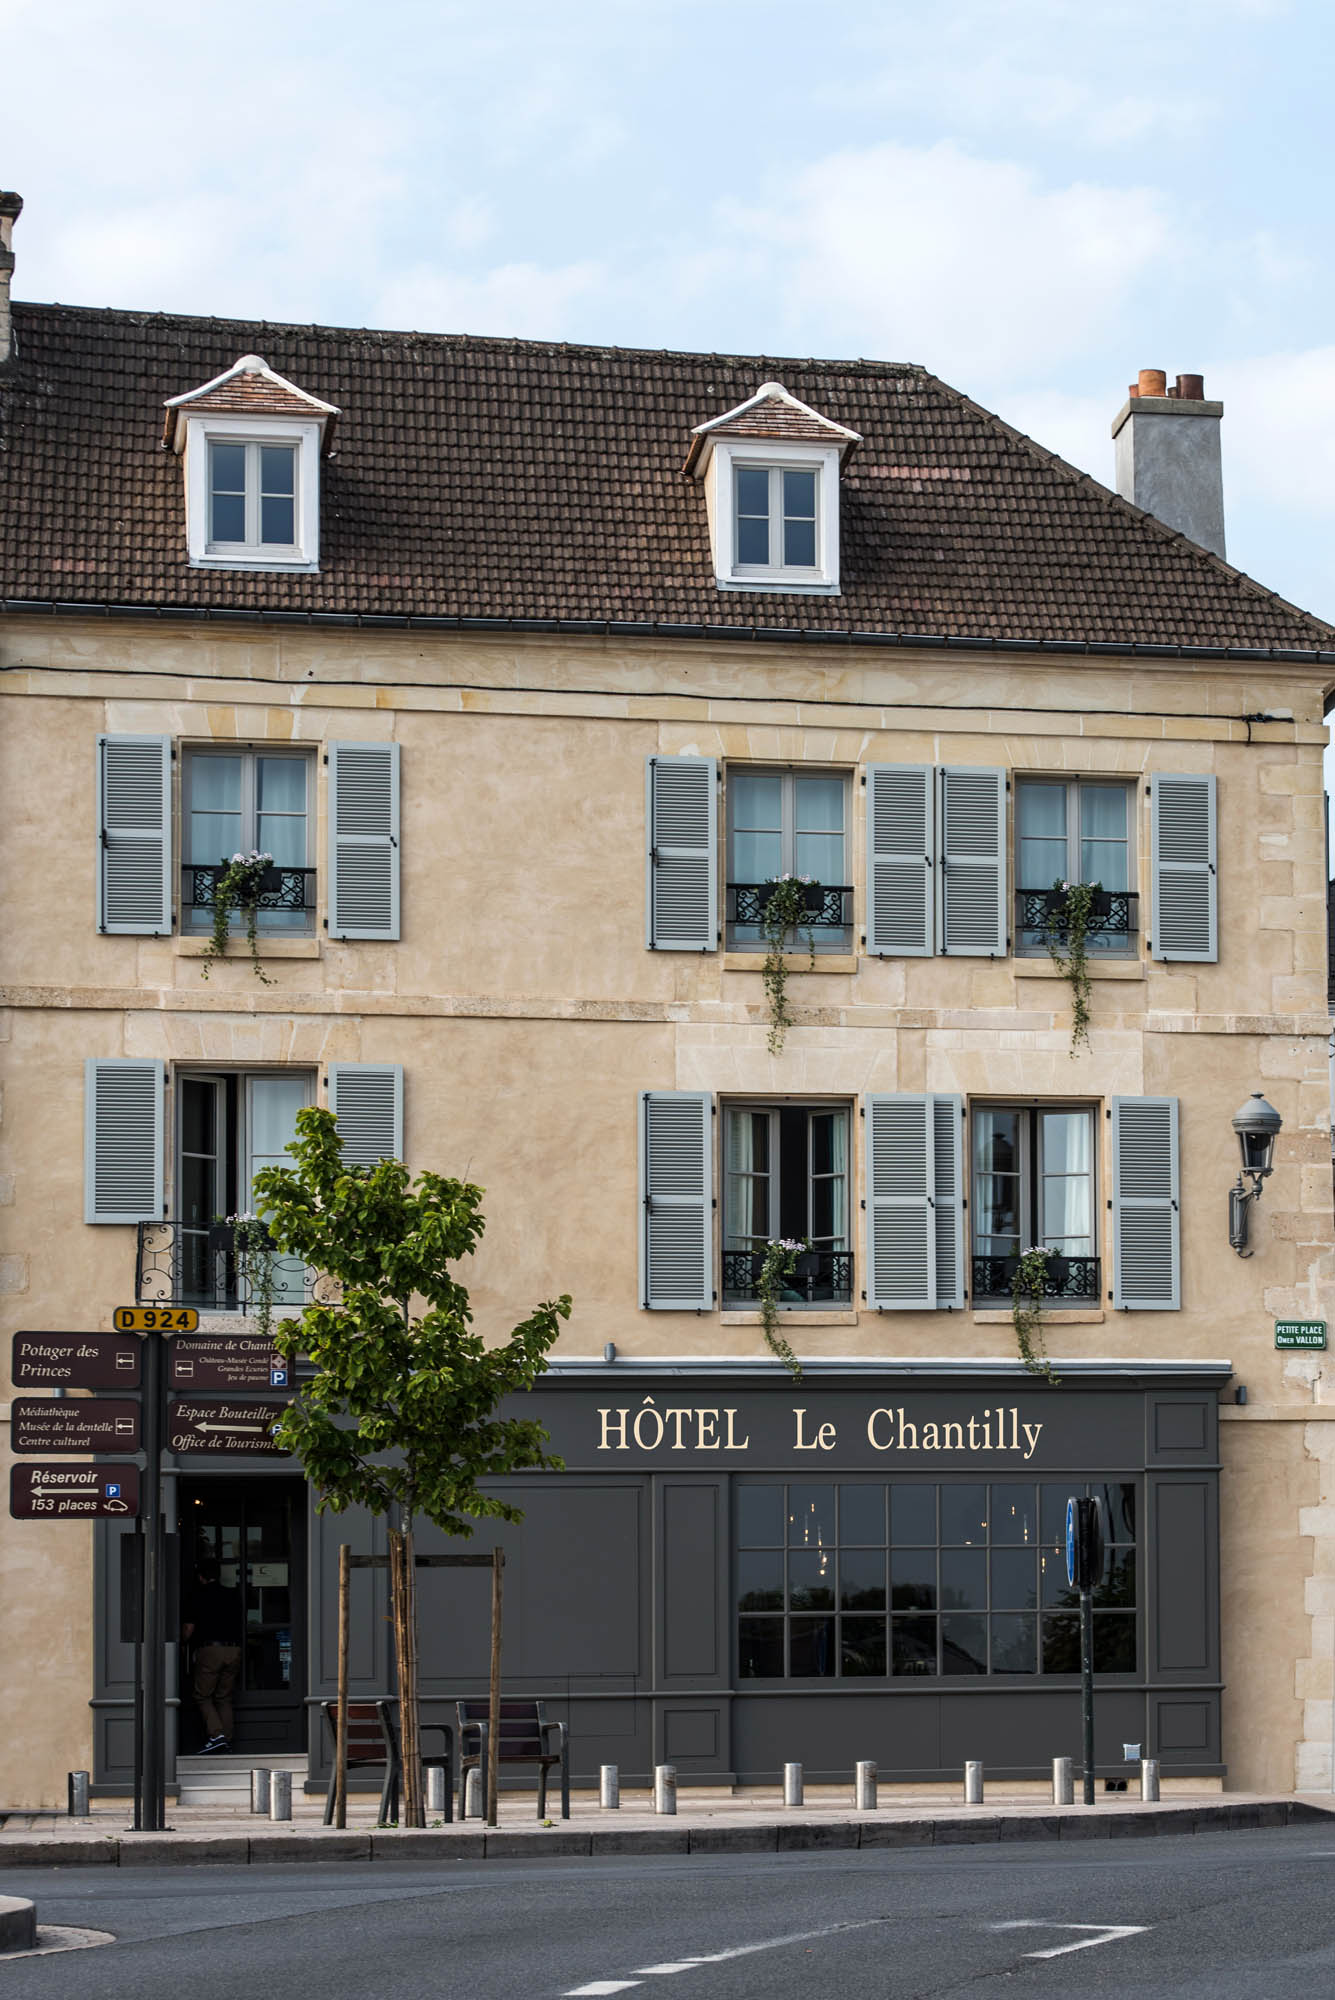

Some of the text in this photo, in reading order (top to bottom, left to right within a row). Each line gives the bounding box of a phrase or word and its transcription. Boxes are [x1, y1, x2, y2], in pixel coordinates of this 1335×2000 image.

[122, 1311, 189, 1328] D 924
[1277, 1326, 1322, 1334] PETITE PLACE
[176, 1340, 222, 1350] Domaine
[225, 1341, 237, 1350] de
[1295, 1336, 1323, 1344] VALLON
[19, 1343, 99, 1361] Potager des
[20, 1364, 71, 1377] Princes
[273, 1372, 284, 1384] P
[19, 1407, 80, 1420] Médiathèque
[176, 1405, 278, 1421] Espace Bouteiller
[19, 1422, 113, 1432] Musée de la dentelle
[596, 1395, 1044, 1460] HÔTEL Le Chantilly
[19, 1436, 91, 1447] Centre culturel
[172, 1434, 277, 1450] Office de Tourisme
[31, 1470, 98, 1484] Réservoir
[31, 1499, 97, 1513] 153 places
